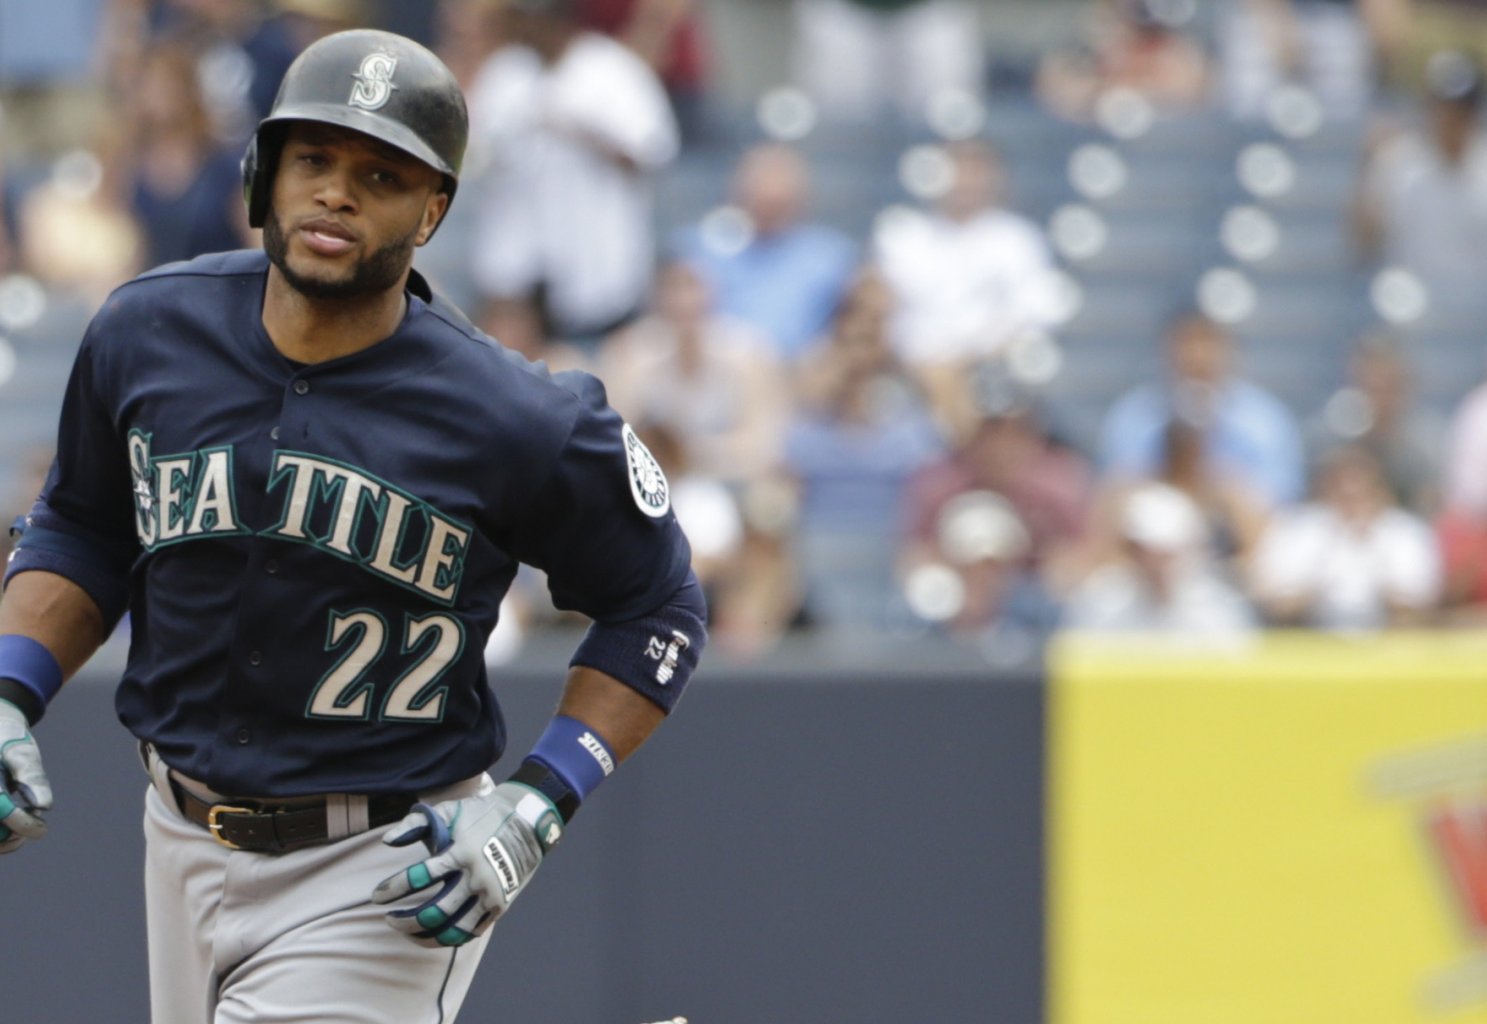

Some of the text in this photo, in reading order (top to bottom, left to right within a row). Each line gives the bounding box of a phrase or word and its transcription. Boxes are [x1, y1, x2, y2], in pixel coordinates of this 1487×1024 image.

[349, 53, 398, 110] S
[127, 428, 474, 607] SEATTLE
[305, 607, 466, 722] 22
[644, 635, 666, 660] 22
